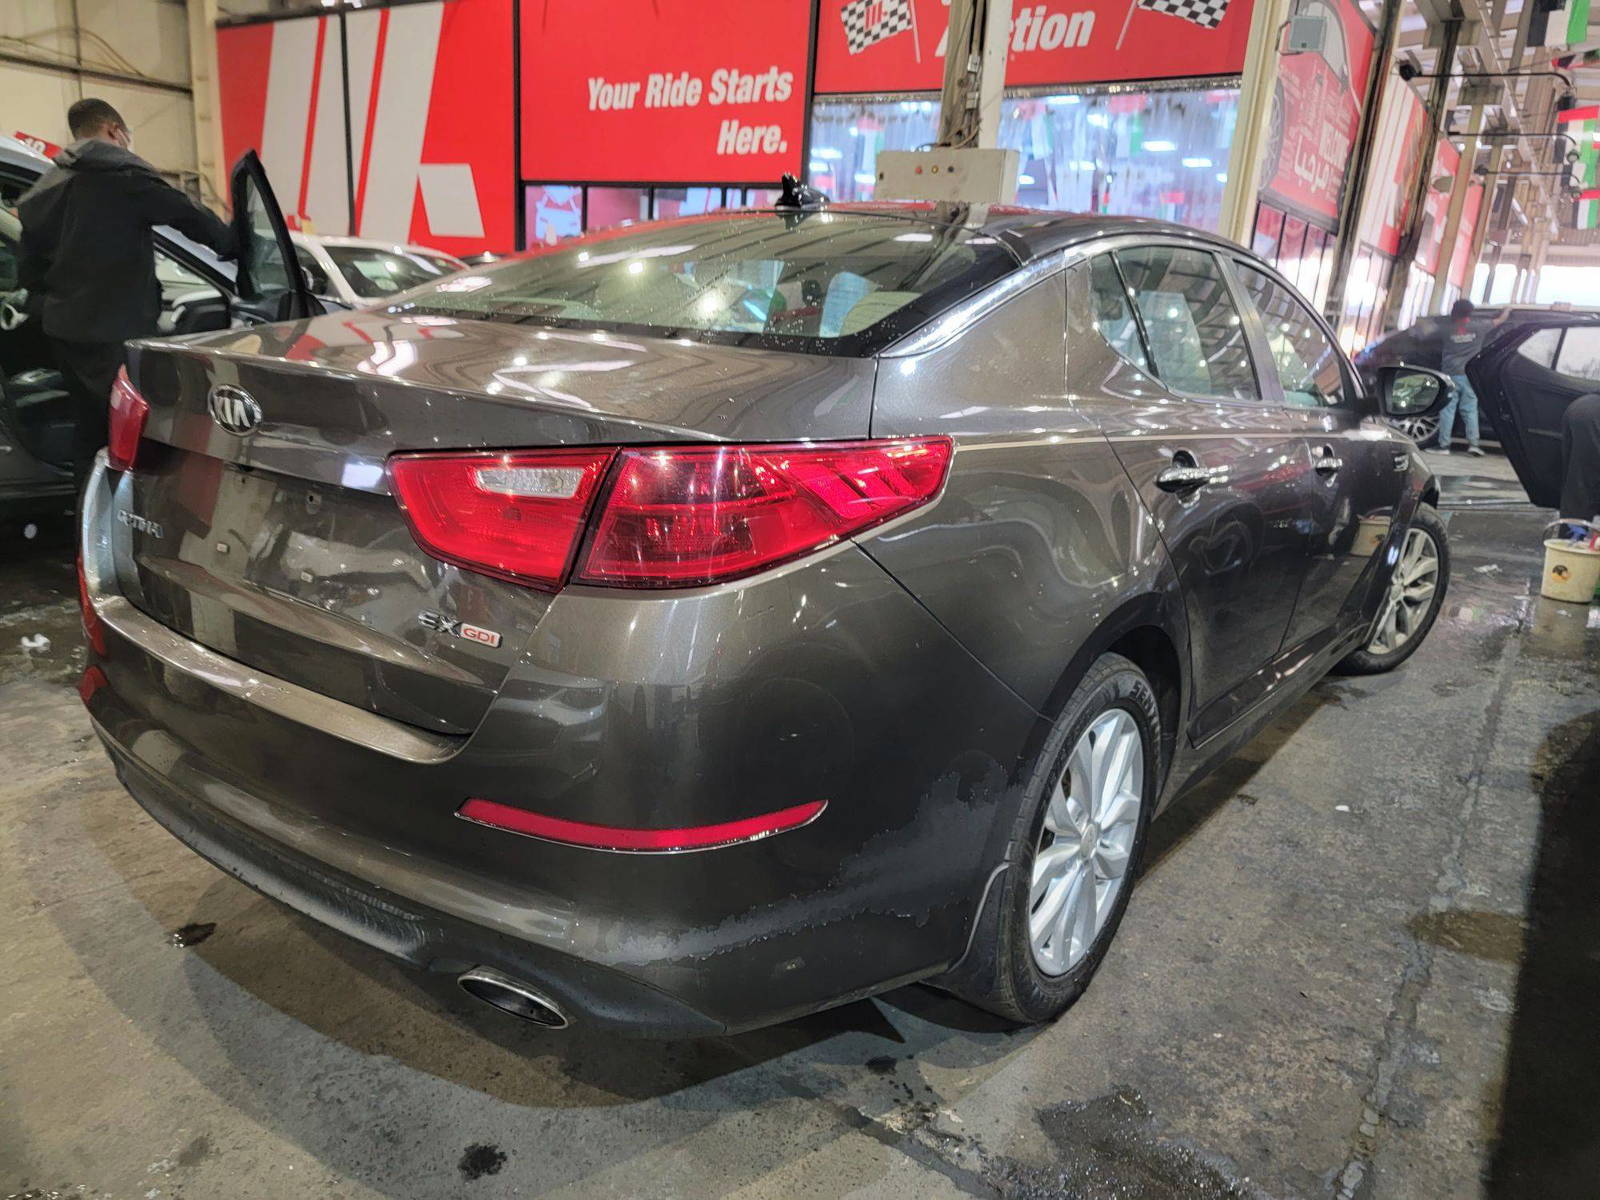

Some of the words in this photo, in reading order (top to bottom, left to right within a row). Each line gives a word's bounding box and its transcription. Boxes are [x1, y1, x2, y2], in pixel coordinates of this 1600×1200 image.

[588, 77, 641, 111] Your
[645, 72, 703, 108] Ride
[708, 66, 794, 106] Starts
[716, 119, 788, 155] Here.
[463, 627, 497, 646] GDI
